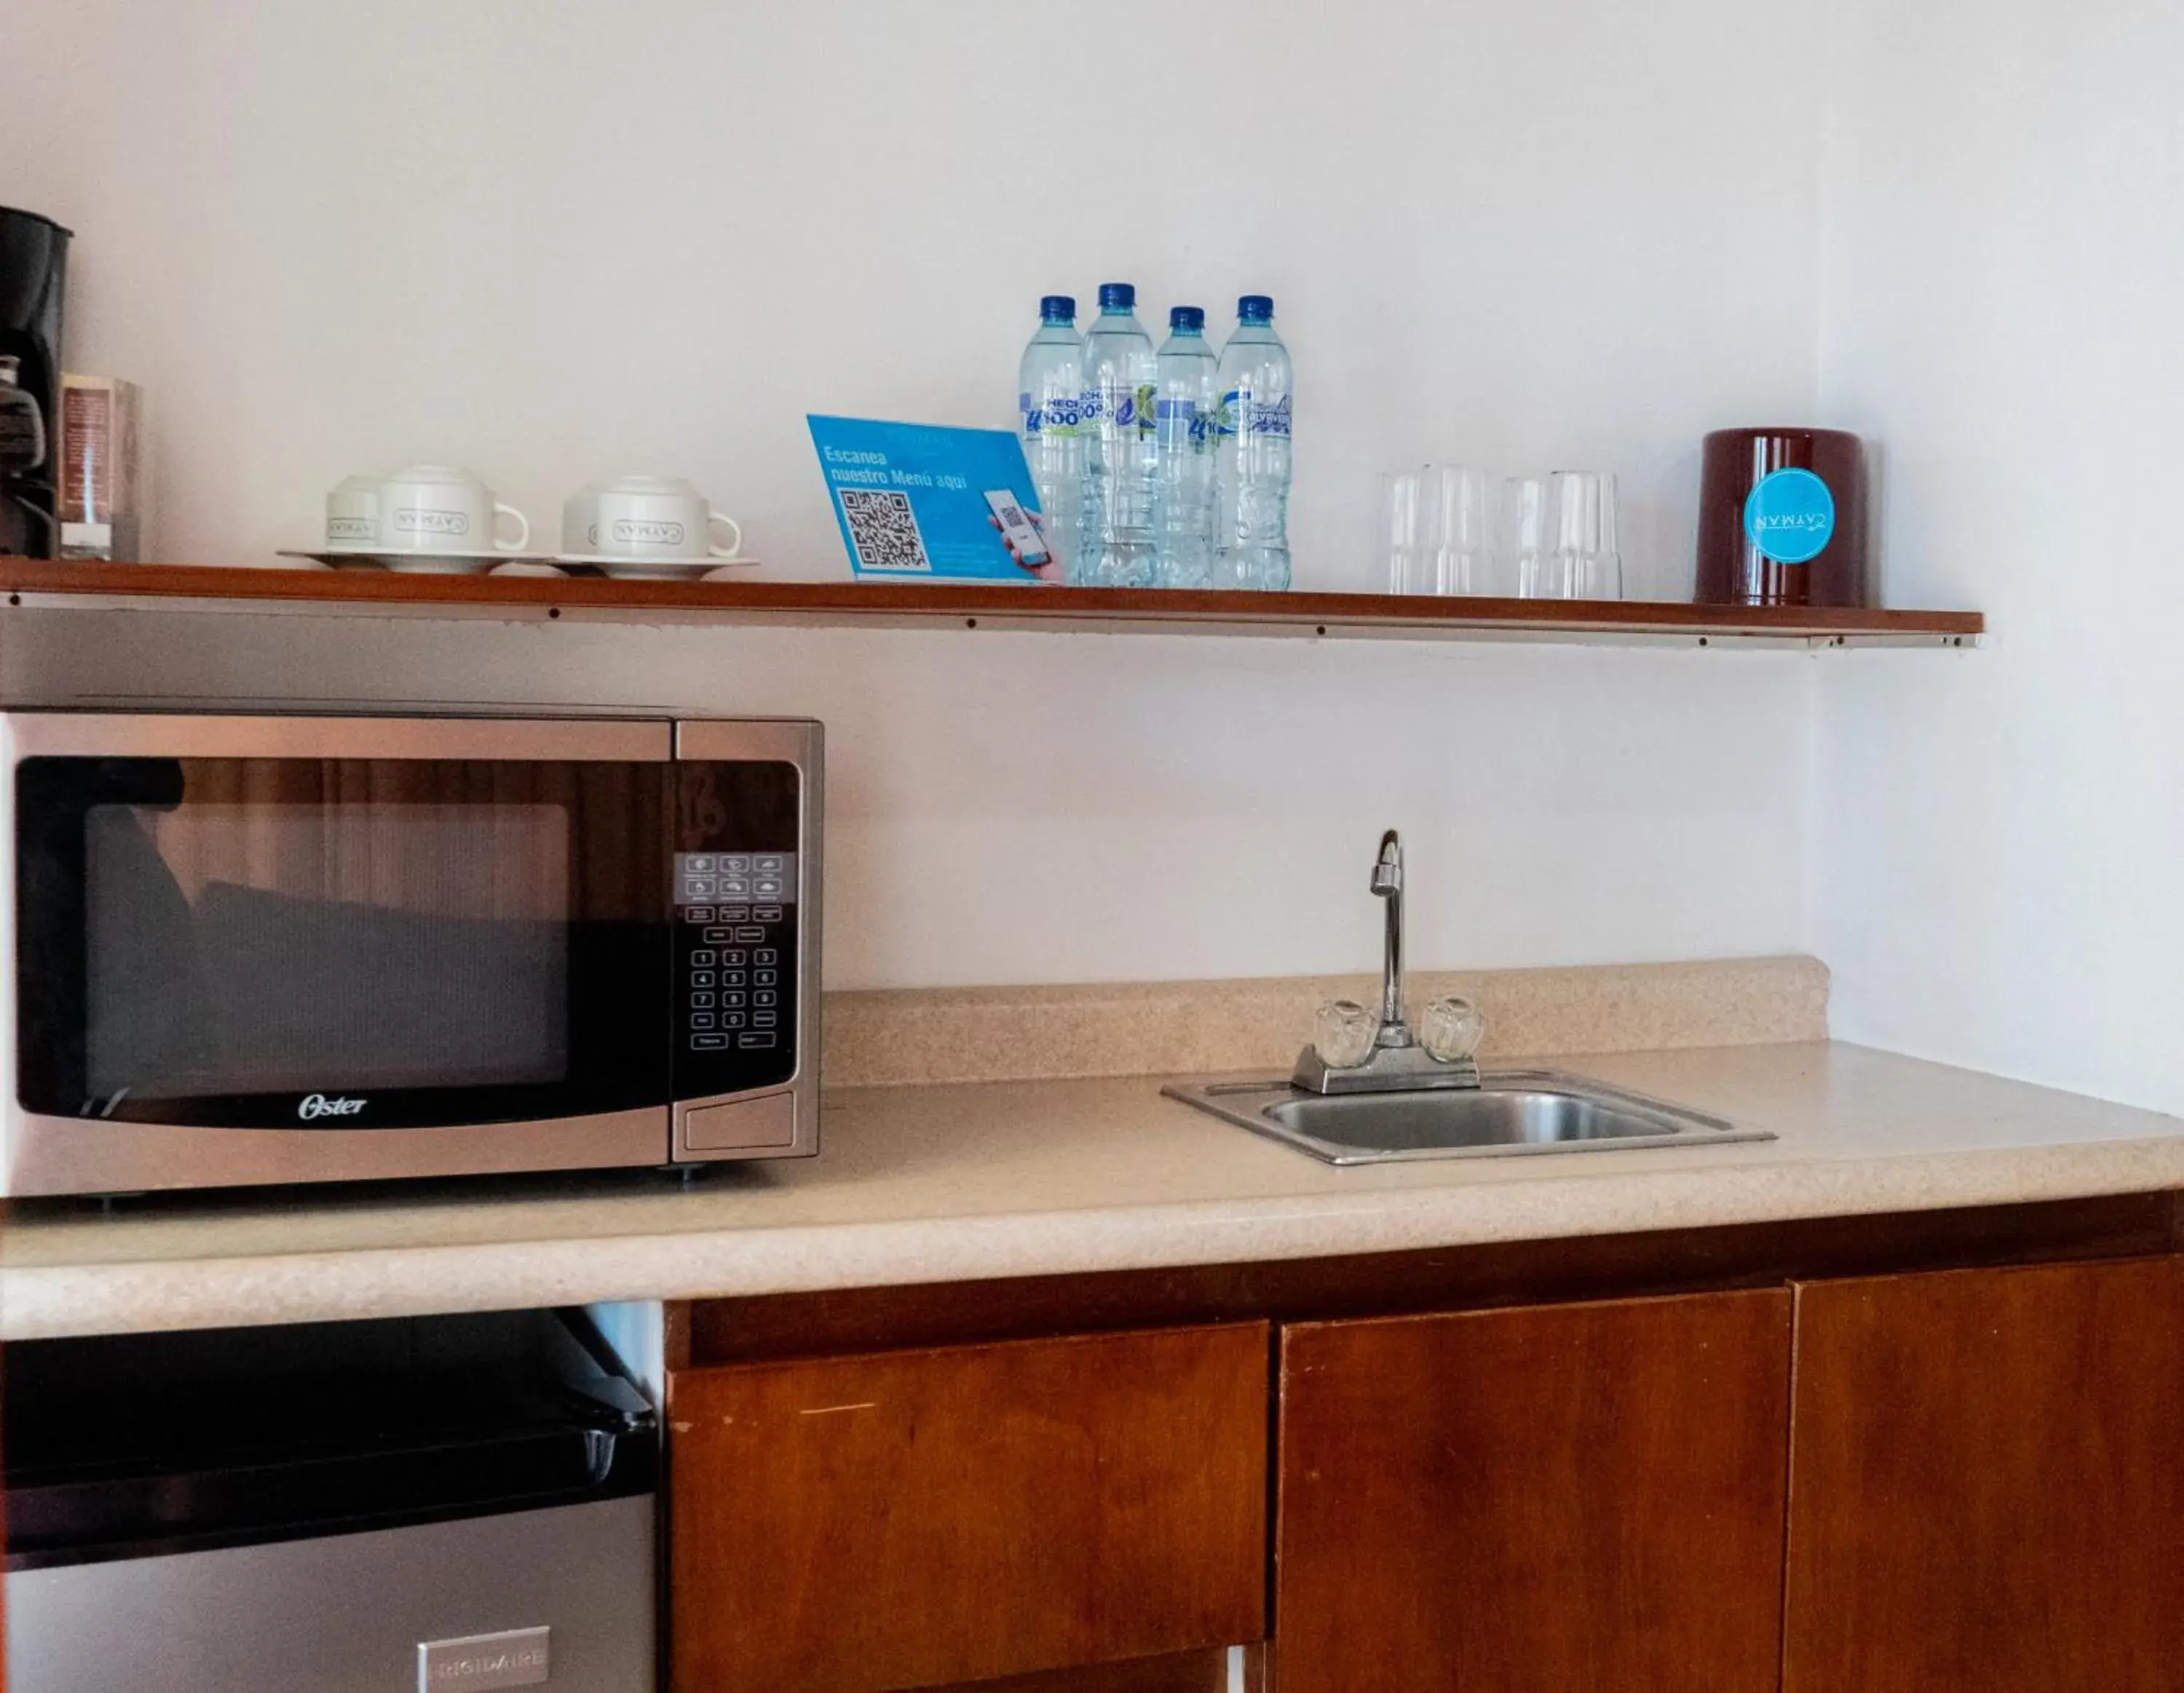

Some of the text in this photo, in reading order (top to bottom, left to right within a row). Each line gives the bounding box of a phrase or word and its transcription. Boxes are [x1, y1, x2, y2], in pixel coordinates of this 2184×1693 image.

[823, 445, 887, 465] Escanea
[831, 468, 888, 484] nuestro
[890, 469, 933, 487] Menú
[1754, 512, 1826, 528] CAYMAN
[298, 1093, 368, 1120] Oster
